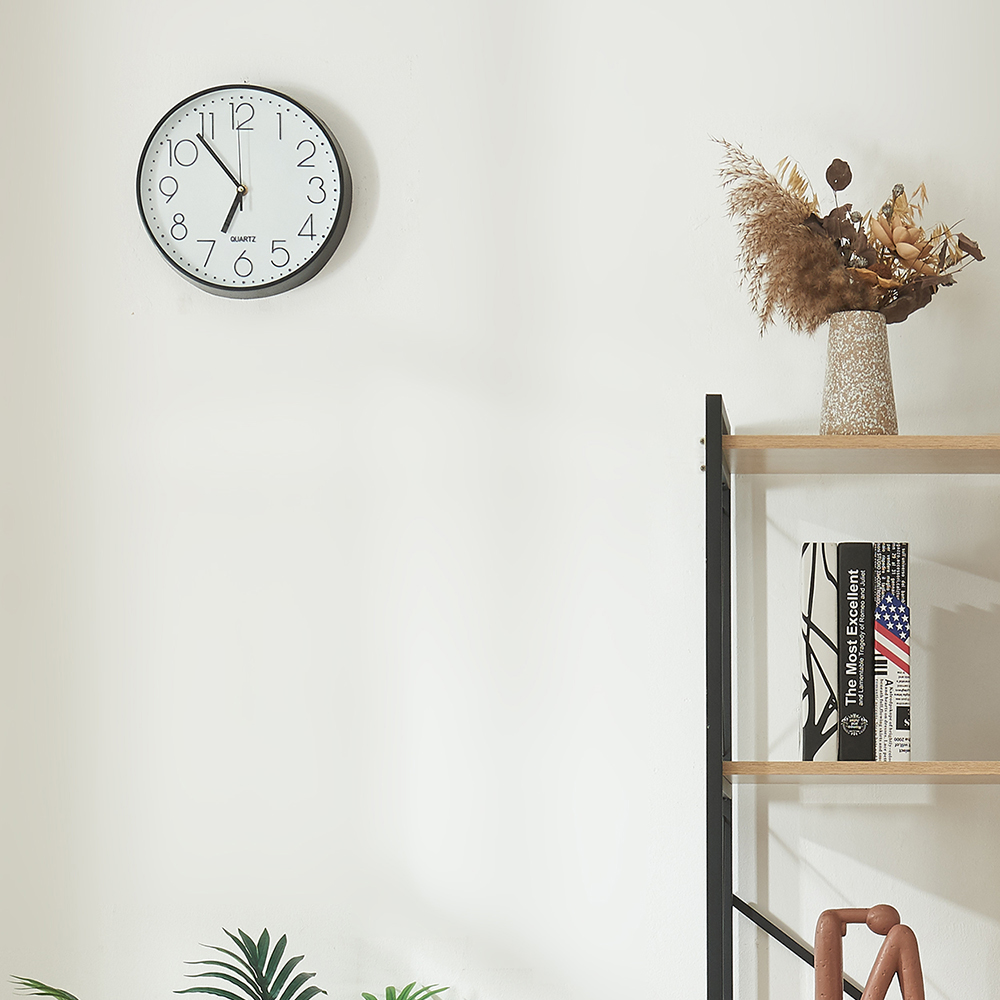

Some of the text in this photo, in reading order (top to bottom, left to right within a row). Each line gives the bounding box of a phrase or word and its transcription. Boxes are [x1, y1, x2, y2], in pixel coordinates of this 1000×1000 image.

[198, 112, 214, 140] 11
[229, 102, 255, 130] 12
[276, 112, 282, 140] 1
[166, 138, 198, 167] 10
[296, 140, 316, 167] 2
[158, 176, 179, 204] 9
[306, 176, 327, 204] 3
[170, 213, 188, 241] 8
[297, 214, 317, 241] 4
[197, 240, 216, 268] 7
[234, 250, 254, 277] 6
[270, 240, 290, 268] 5
[846, 569, 859, 636] Excellent
[845, 640, 858, 675] Most
[858, 631, 866, 656] Tragedy
[845, 679, 858, 706] The
